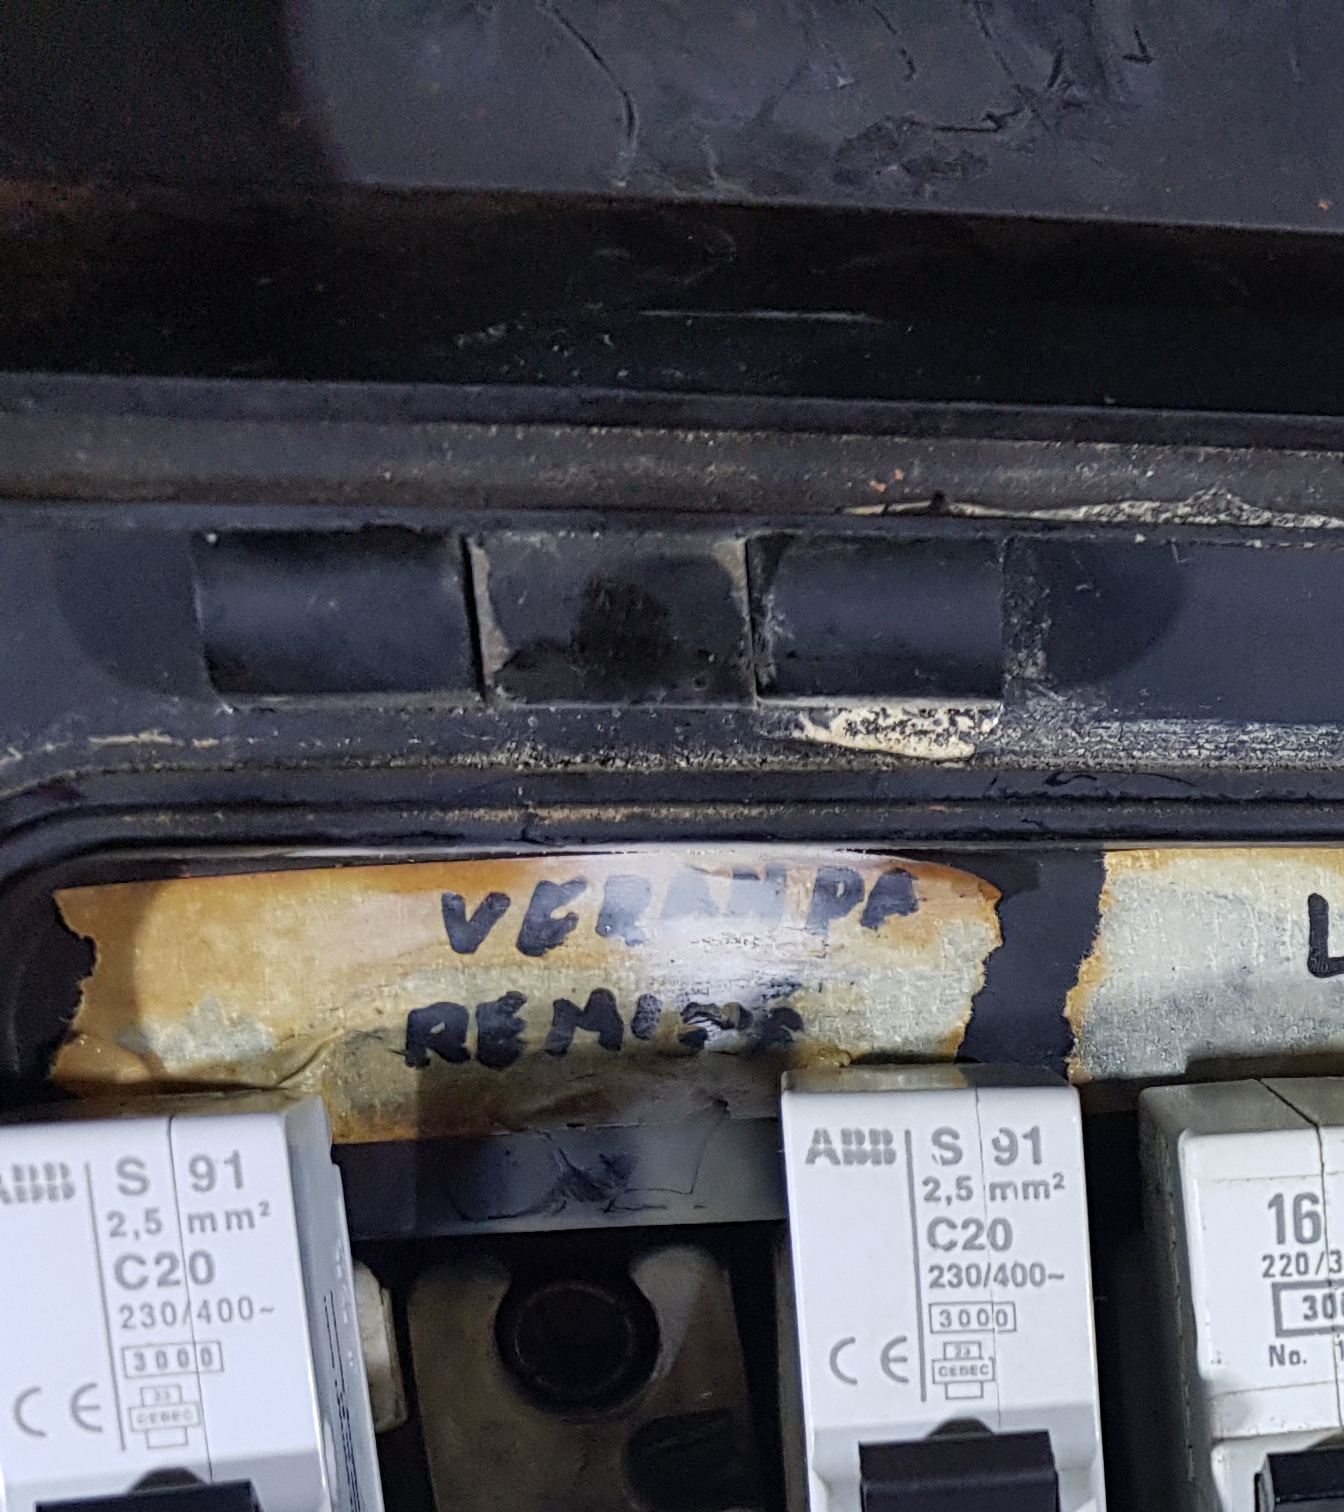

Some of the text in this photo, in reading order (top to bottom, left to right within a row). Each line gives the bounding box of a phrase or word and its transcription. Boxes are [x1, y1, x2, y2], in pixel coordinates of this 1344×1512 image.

[805, 1128, 896, 1165] ABB
[931, 1126, 1042, 1166] S 91
[116, 1150, 244, 1196] S 91
[922, 1176, 973, 1206] 2,5
[107, 1207, 163, 1241] 2,5
[927, 1216, 1013, 1252] C20
[1267, 1192, 1321, 1245] 16
[114, 1250, 216, 1290] C20
[940, 1308, 1008, 1328] 3000
[134, 1347, 213, 1372] 3000
